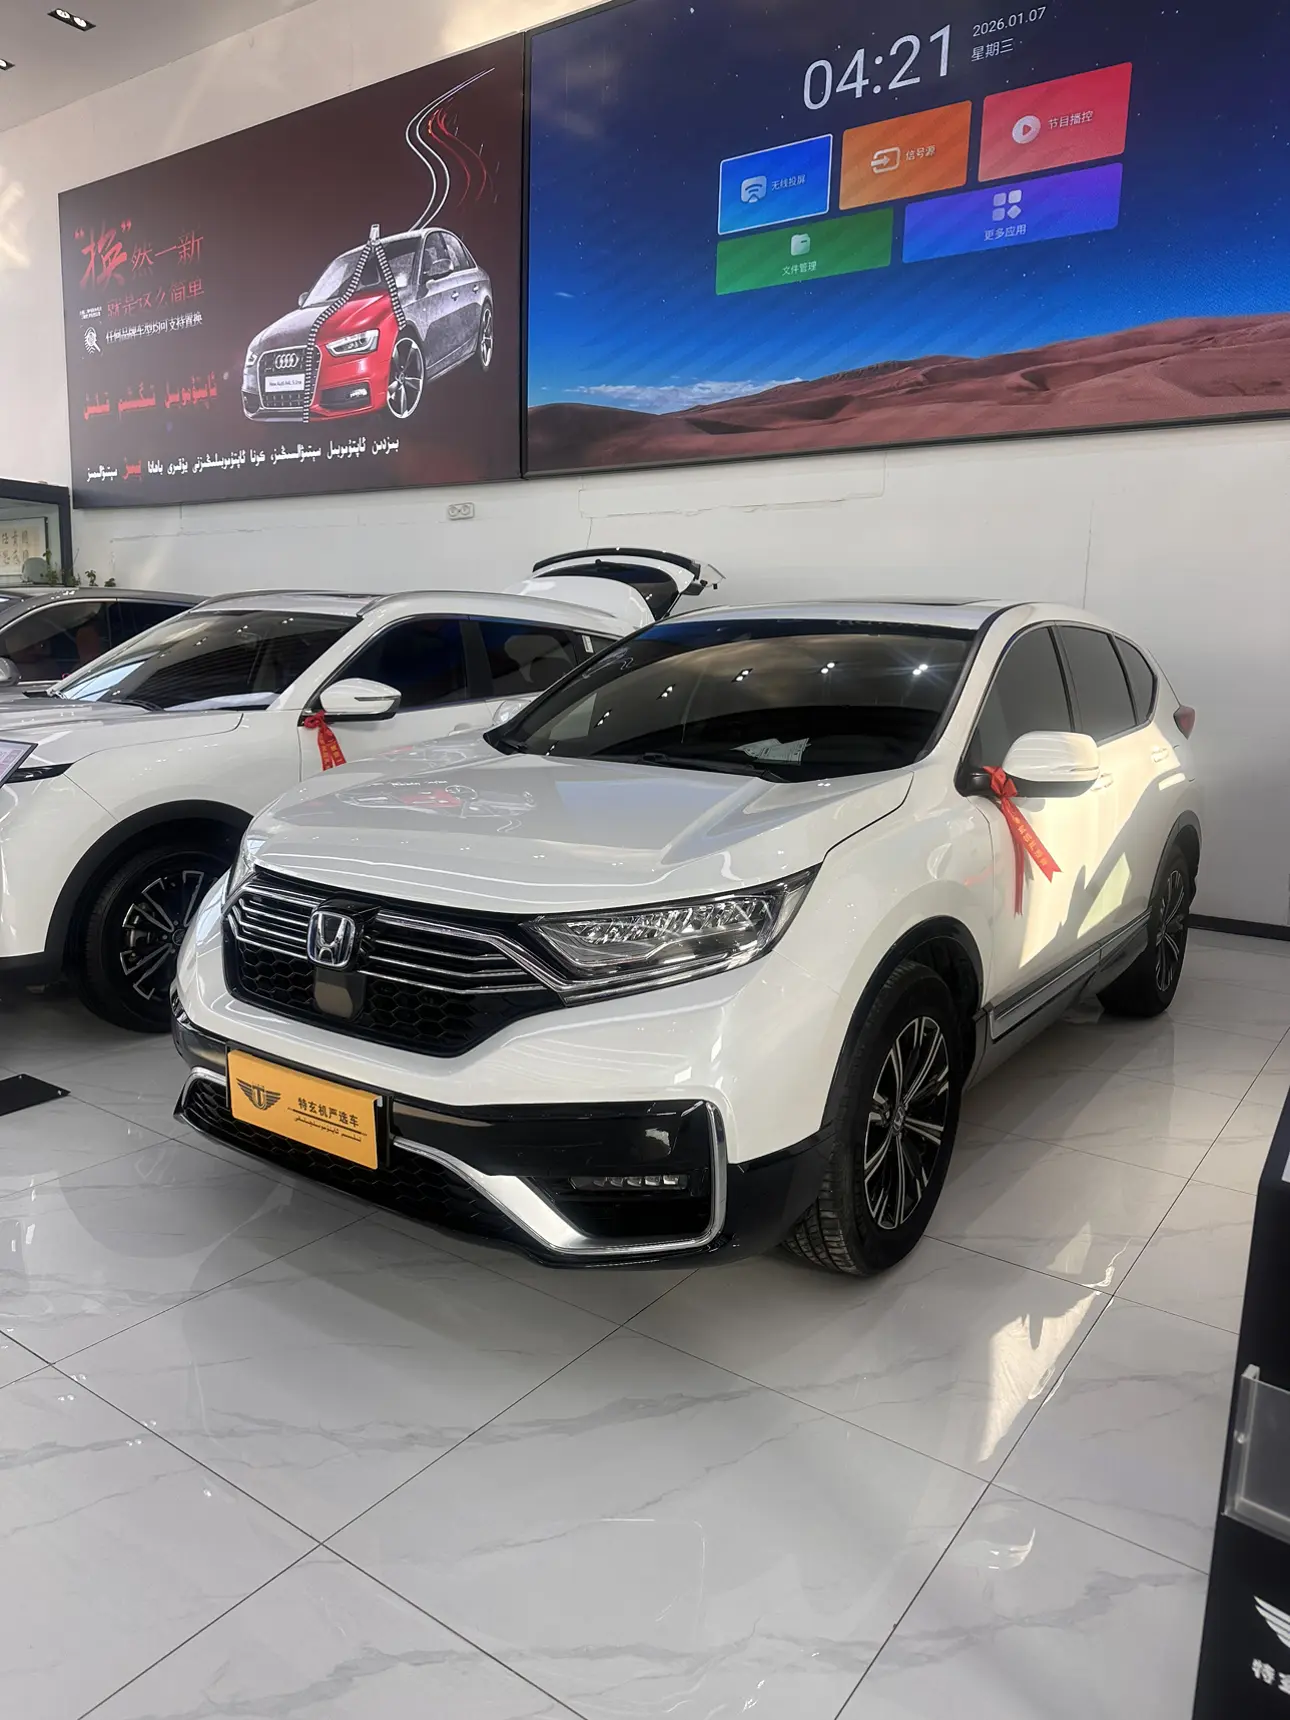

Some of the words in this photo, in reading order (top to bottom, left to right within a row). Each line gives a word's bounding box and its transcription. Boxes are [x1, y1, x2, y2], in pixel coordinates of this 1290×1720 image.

[972, 6, 1047, 37] 2026.01.07
[971, 38, 1014, 62] 星期三
[803, 24, 951, 110] 04:21
[1047, 110, 1093, 130] 节目播控
[905, 144, 936, 161] 信号源
[771, 174, 806, 191] 无线投屏
[984, 224, 1027, 242] 更多应用
[782, 260, 817, 276] 文件管理
[298, 1097, 359, 1128] 特玄机严选车
